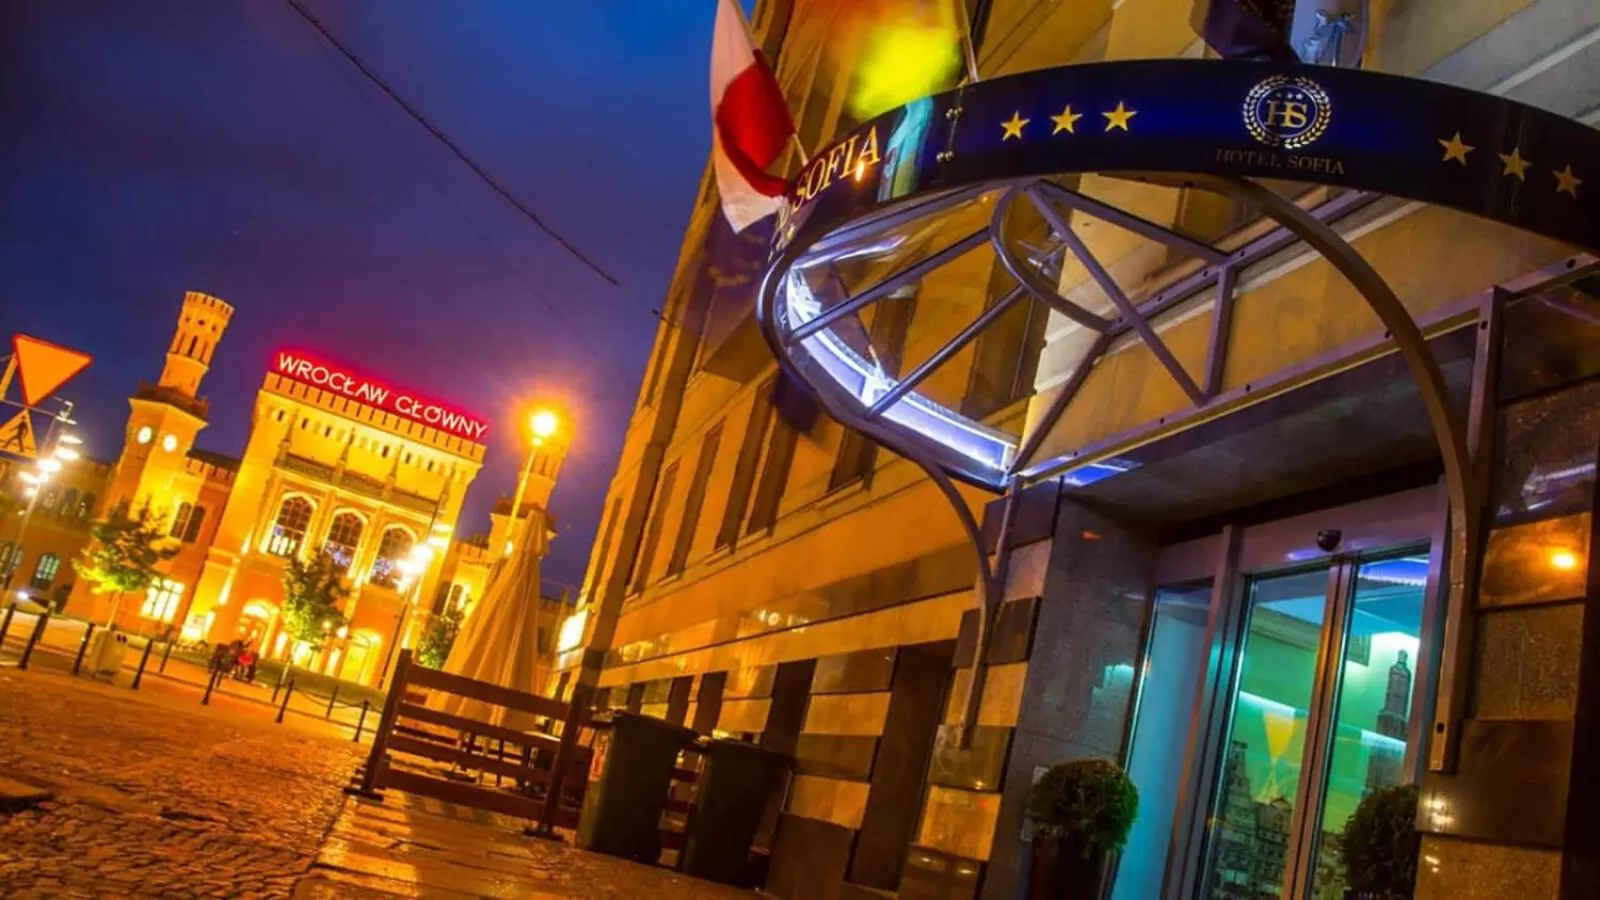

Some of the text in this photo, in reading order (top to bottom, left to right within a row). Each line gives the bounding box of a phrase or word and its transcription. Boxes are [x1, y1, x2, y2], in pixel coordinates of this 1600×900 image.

[790, 125, 880, 213] SOFIA
[1215, 148, 1346, 176] HOTEL SOFIA
[279, 352, 389, 405] WROCŁAW
